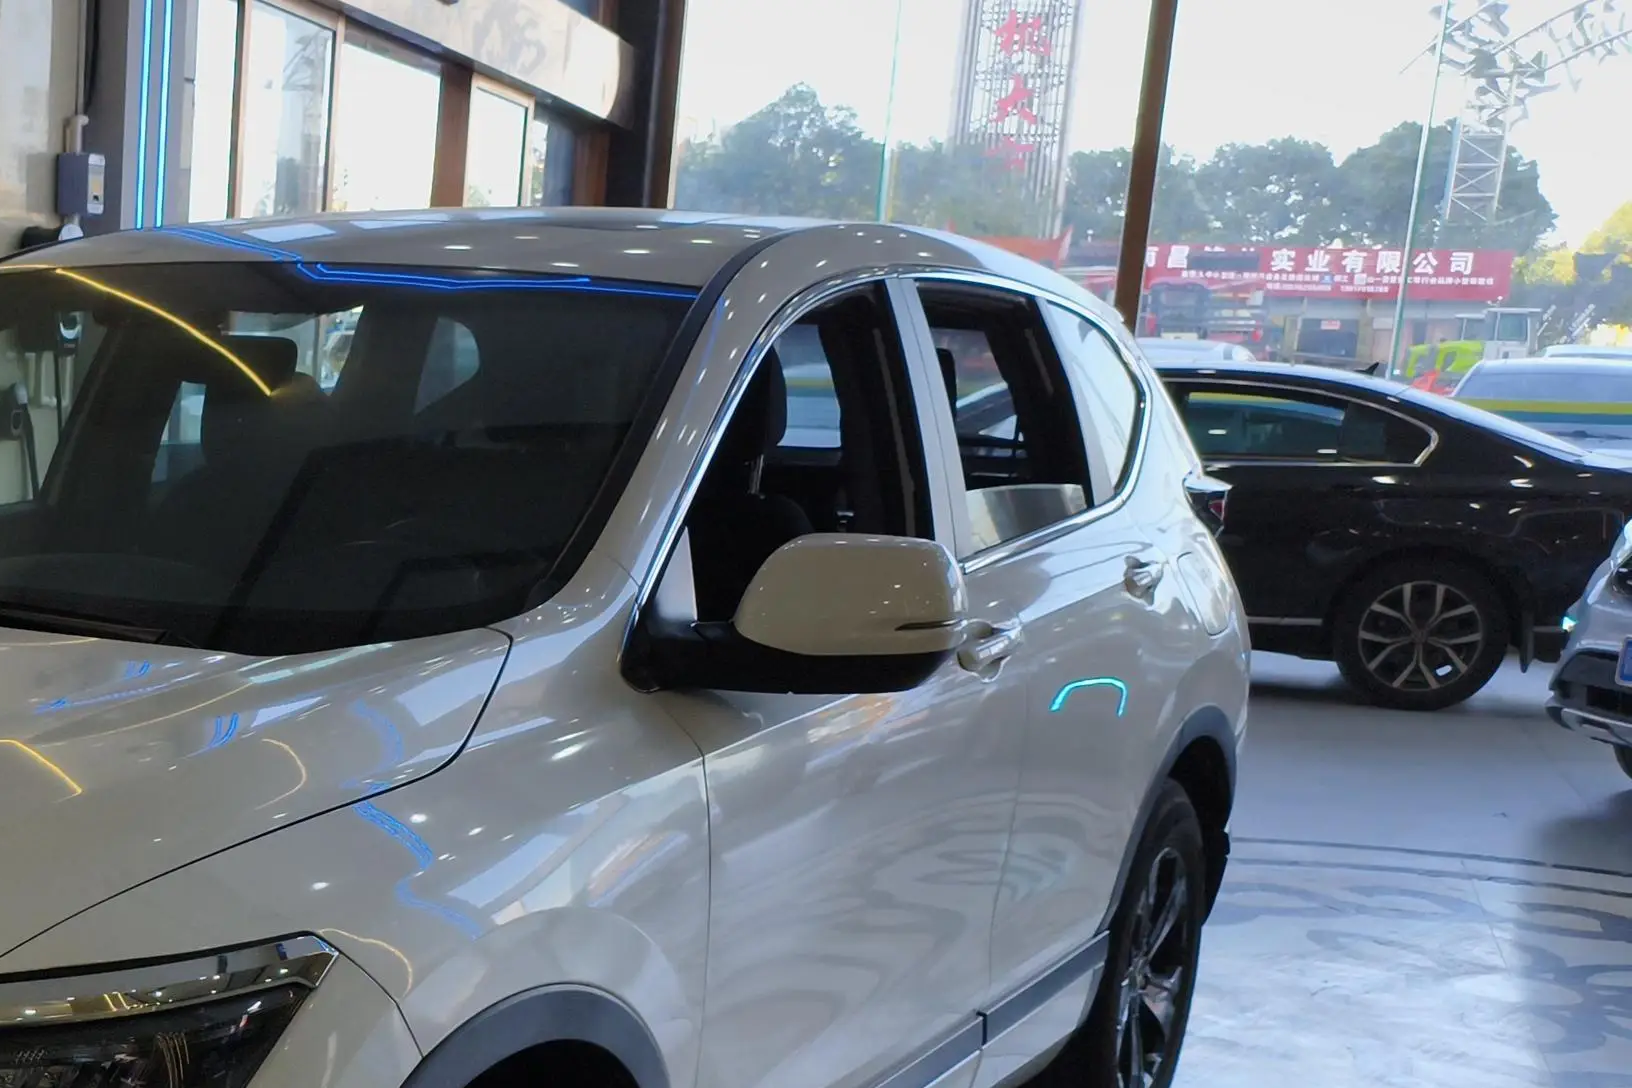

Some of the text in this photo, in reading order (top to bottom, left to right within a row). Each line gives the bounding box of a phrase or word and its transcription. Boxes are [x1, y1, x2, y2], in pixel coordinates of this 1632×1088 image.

[1145, 245, 1474, 275] 昌实业有限公司
